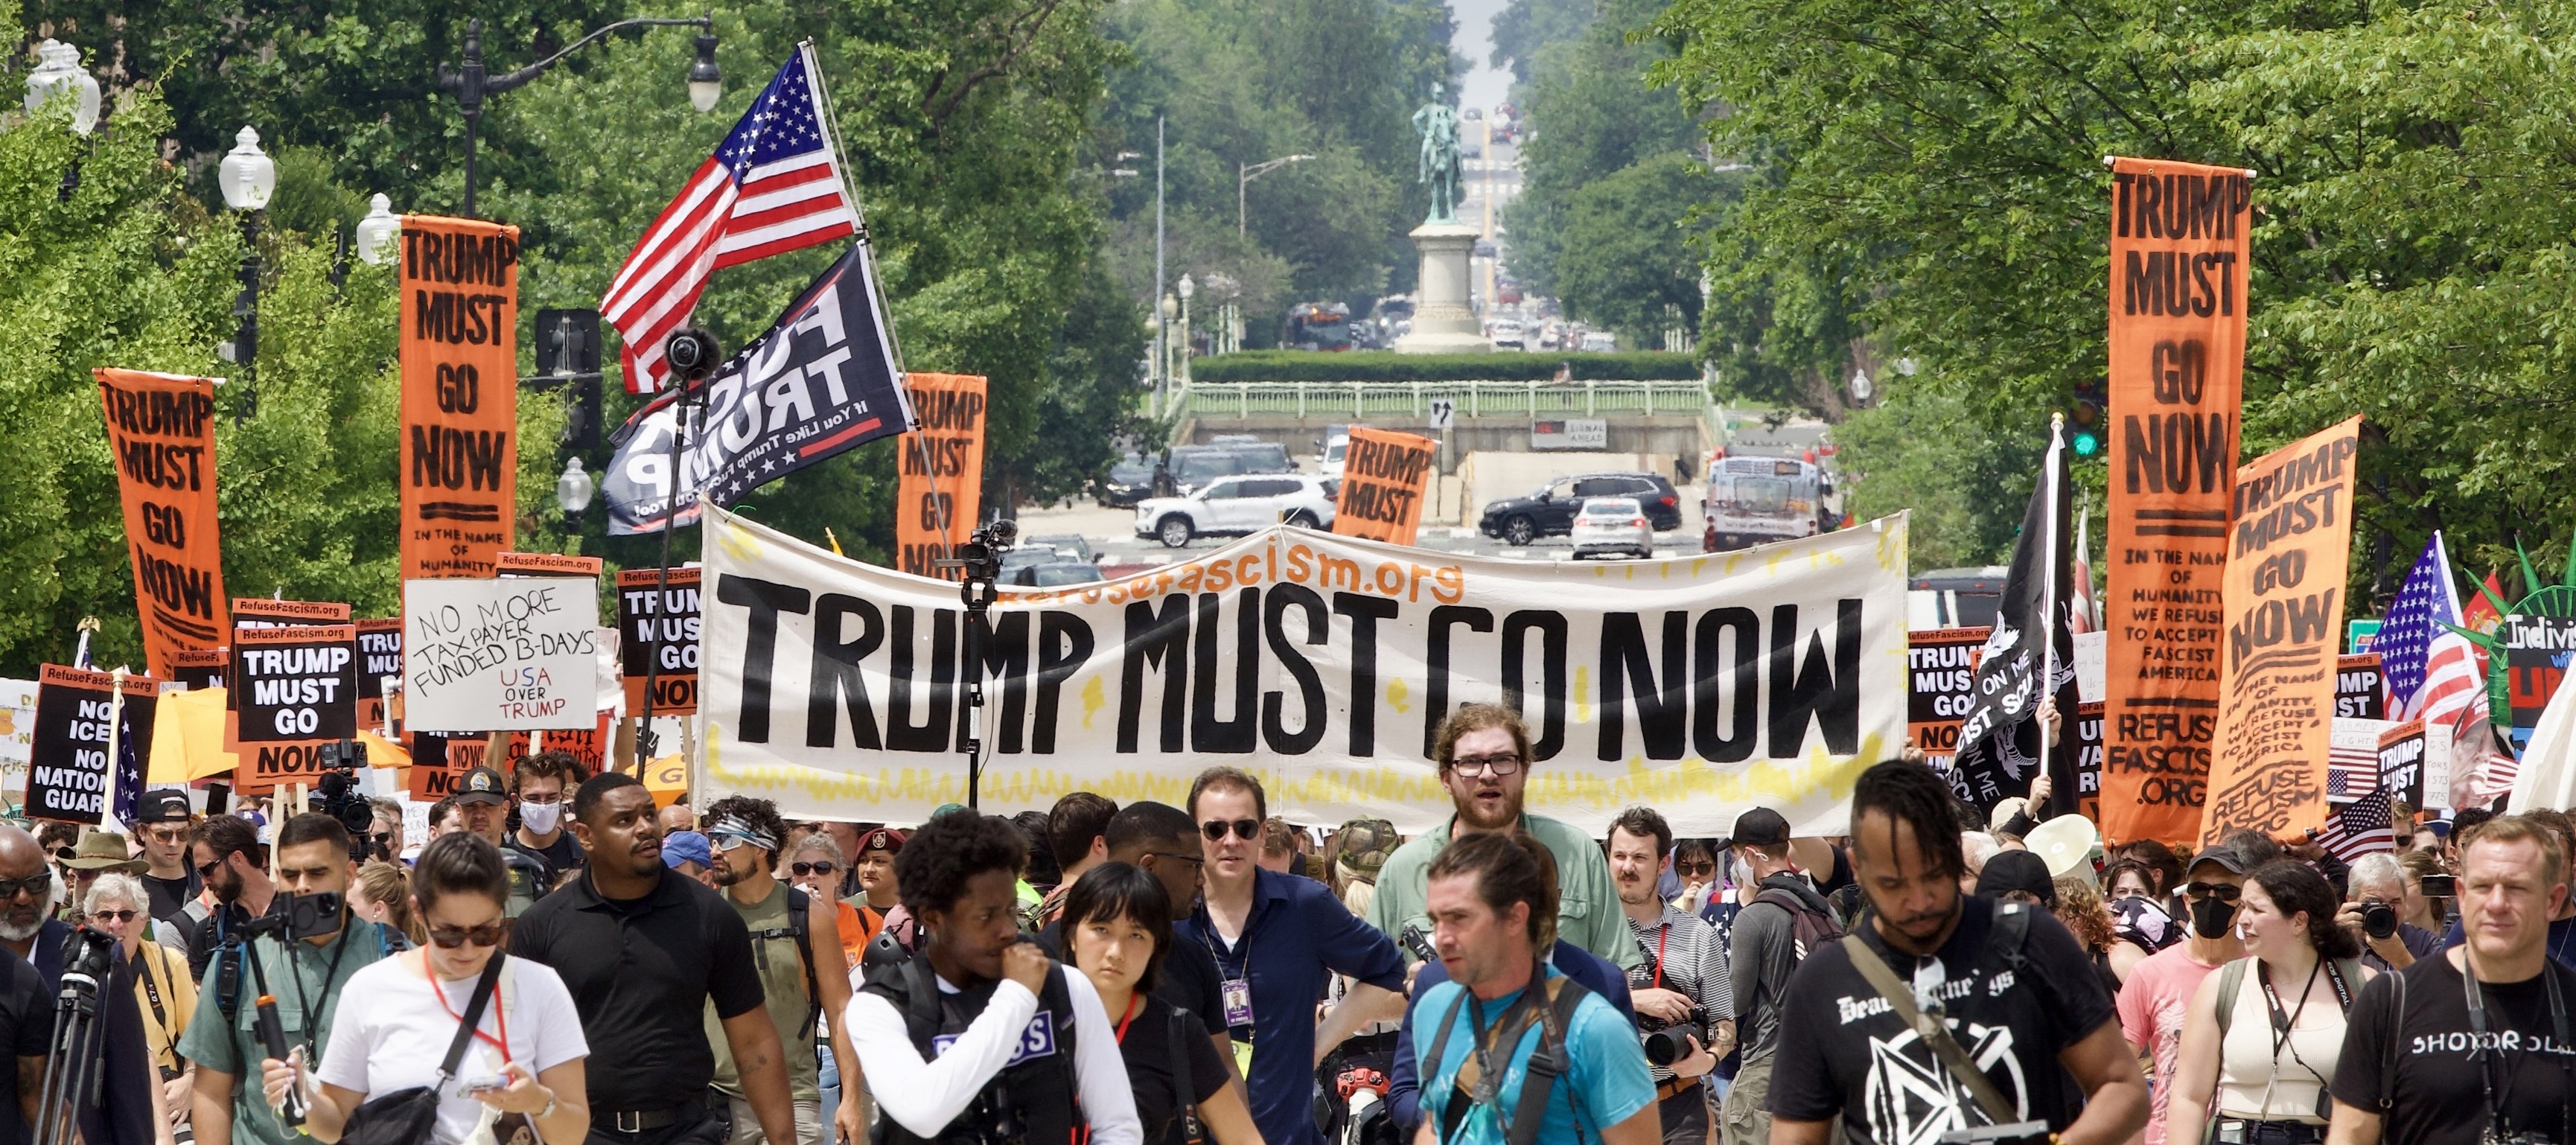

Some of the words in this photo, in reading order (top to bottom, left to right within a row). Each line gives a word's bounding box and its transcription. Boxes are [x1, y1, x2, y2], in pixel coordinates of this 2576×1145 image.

[2114, 173, 2251, 240] TRUMP
[401, 229, 519, 287] TRUMP
[2126, 251, 2236, 318] MUST
[416, 290, 508, 346] MUST
[436, 361, 479, 415] GO
[2152, 339, 2204, 406] GO
[98, 382, 214, 438] TRUMP
[118, 433, 205, 491] MUST
[411, 424, 506, 493] NOW
[905, 437, 973, 477] MUST
[1347, 436, 1433, 485] TRUMP
[2124, 412, 2231, 494] NOW
[2234, 436, 2358, 521] TRUMP
[921, 492, 953, 532] GO
[1342, 479, 1417, 526] MUST
[142, 501, 185, 549] GO
[415, 530, 430, 540] IN
[435, 529, 461, 540] THE
[465, 532, 503, 544] NAME
[2236, 483, 2343, 560] MUST
[420, 559, 496, 572] HUMANITY
[450, 544, 468, 556] OF
[503, 556, 593, 570] RefuseFascism.org
[2125, 549, 2149, 564] IN
[2155, 549, 2182, 564] THE
[136, 543, 213, 621] NOW
[2171, 570, 2193, 584] OF
[2254, 549, 2307, 596] GO
[240, 600, 340, 617] RefuseFascism.org
[418, 604, 462, 641] NO
[477, 587, 561, 629] MORE
[2133, 608, 2158, 621] WE
[243, 627, 345, 640] RefuseFascism.org
[2125, 628, 2148, 640] TO
[2154, 628, 2218, 642] ACCEPT
[2230, 587, 2336, 676] NOW
[242, 647, 350, 676] TRUMP
[414, 644, 507, 697] FUNDED
[516, 631, 595, 661] B-DAYS
[660, 645, 699, 669] GO
[716, 572, 1095, 753] TRUMP
[1116, 582, 1399, 756] MUST
[1597, 598, 1864, 764] NOW
[2143, 647, 2215, 661] FASCIST
[47, 669, 152, 692] RefuseFascm.org
[500, 666, 552, 687] USA
[1983, 669, 2008, 695] ON
[2011, 648, 2030, 678] ME
[2138, 666, 2217, 682] AMERICA
[255, 677, 341, 706] MUST
[505, 688, 546, 702] OVER
[649, 679, 698, 706] NO
[1934, 695, 1969, 716] GO
[2225, 698, 2242, 718] IN
[2274, 668, 2325, 684] NAME
[2255, 686, 2278, 699] OF
[78, 699, 112, 721] NO
[274, 708, 319, 735] GO
[499, 698, 567, 719] TRUMP
[69, 720, 111, 742] ICE
[1921, 725, 1963, 748] NO
[2119, 713, 2218, 742] REFUS
[2228, 727, 2248, 745] WE
[2251, 708, 2316, 727] REFUSE
[74, 748, 106, 770] NO
[453, 744, 484, 768] NOW!
[2221, 744, 2241, 760] TO
[2232, 743, 2303, 776] AMERICA
[2237, 732, 2302, 763] FASCIST
[2379, 739, 2423, 772] TRUMP
[1975, 771, 2000, 802] ME
[2137, 779, 2207, 807] .ORG
[2213, 769, 2314, 826] REFUSE
[2203, 785, 2318, 846] FASCISM
[2327, 962, 2337, 976] EOS
[2334, 977, 2350, 1007] DIGITAL
